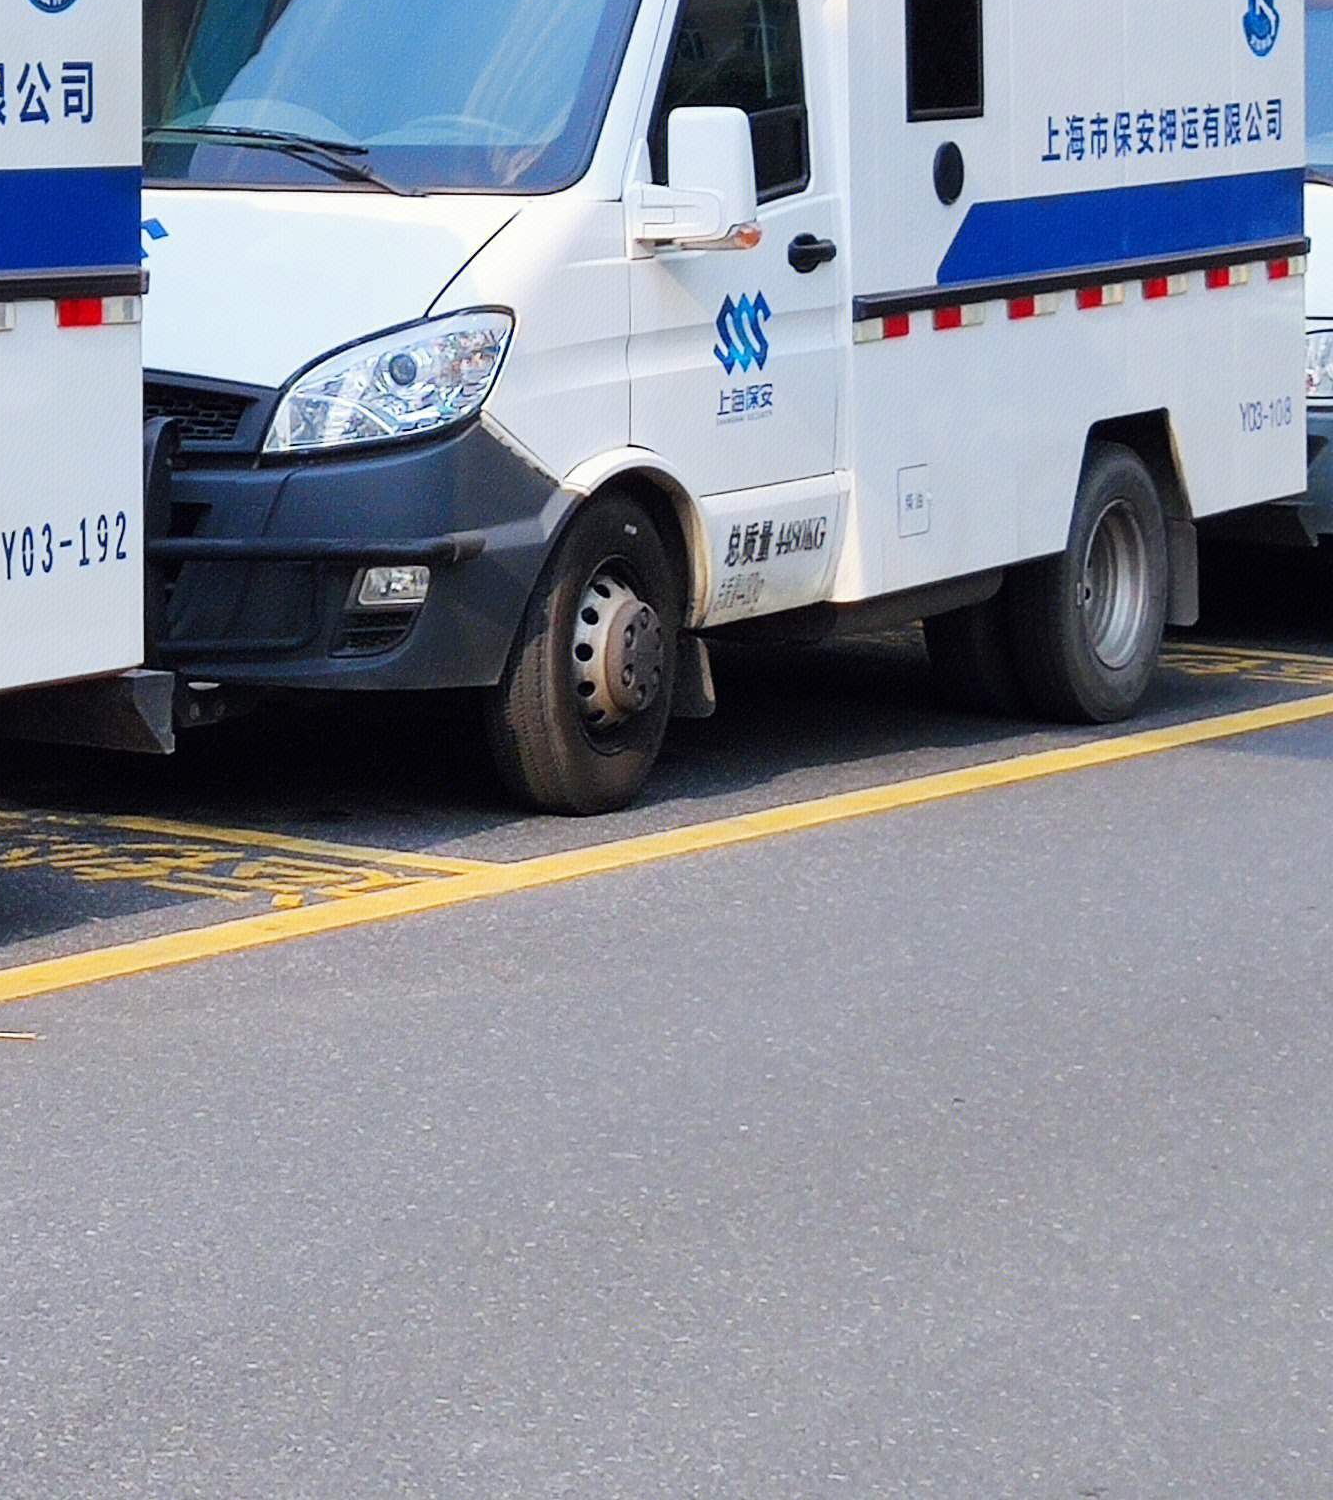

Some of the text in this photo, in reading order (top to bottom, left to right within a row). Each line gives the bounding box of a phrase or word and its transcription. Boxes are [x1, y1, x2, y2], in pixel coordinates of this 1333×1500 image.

[1041, 98, 1282, 162] 上海市保安押运有限公司
[1, 511, 126, 580] Y03-192
